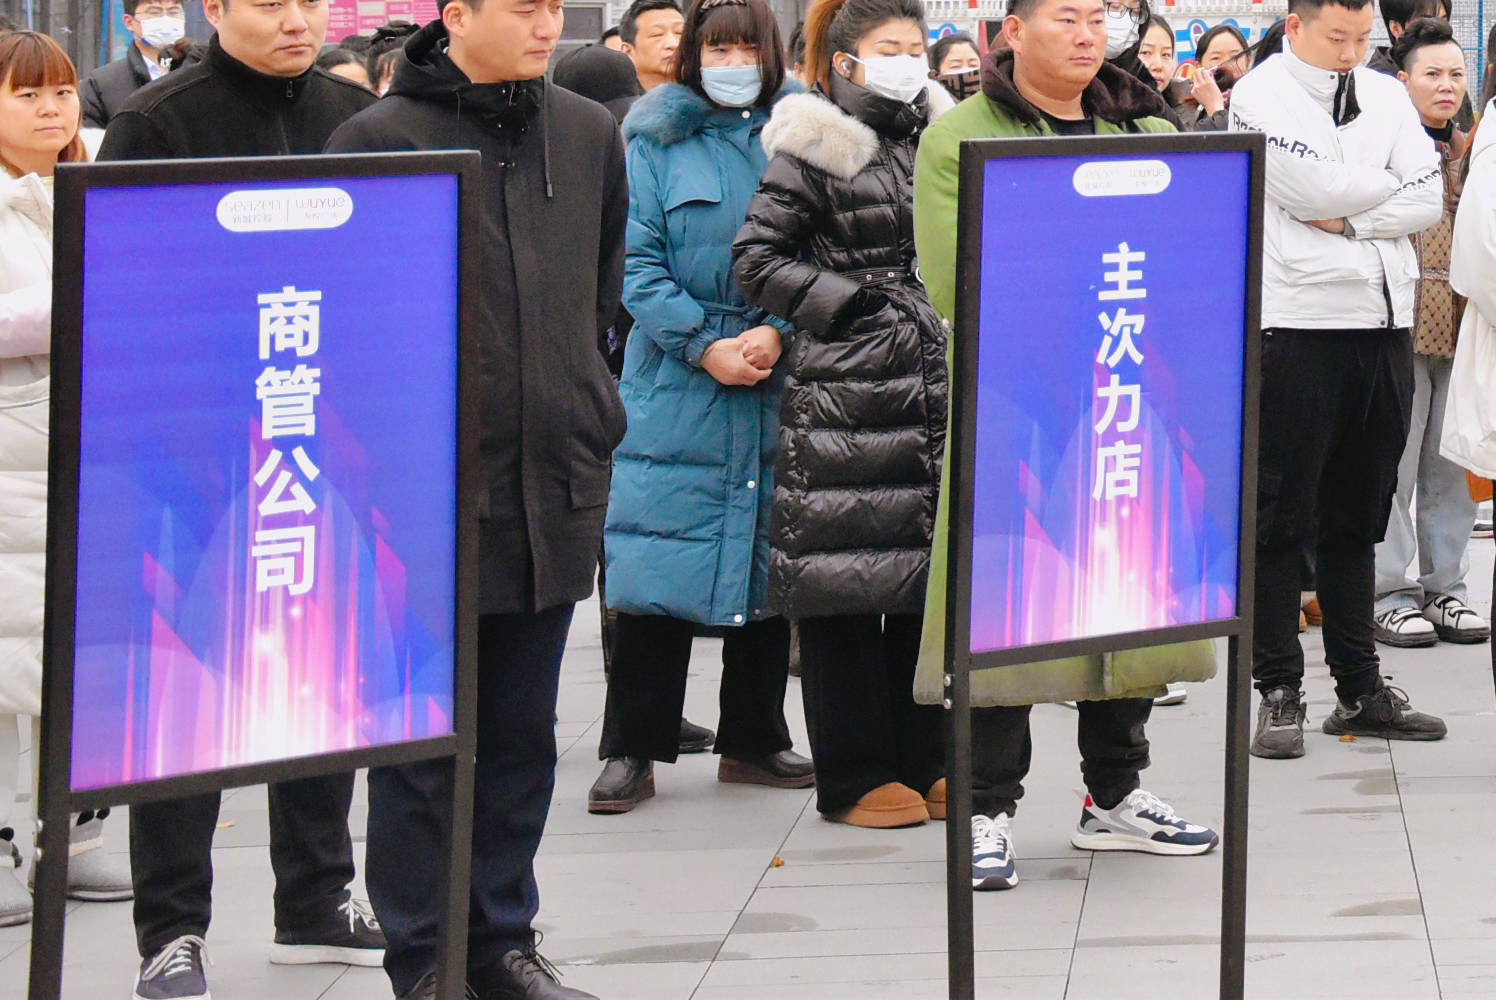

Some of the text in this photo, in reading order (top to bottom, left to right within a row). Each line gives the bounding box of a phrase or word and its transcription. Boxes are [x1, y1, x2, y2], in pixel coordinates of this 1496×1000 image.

[250, 285, 323, 597] 商管公司
[1092, 241, 1148, 501] 主次力店
